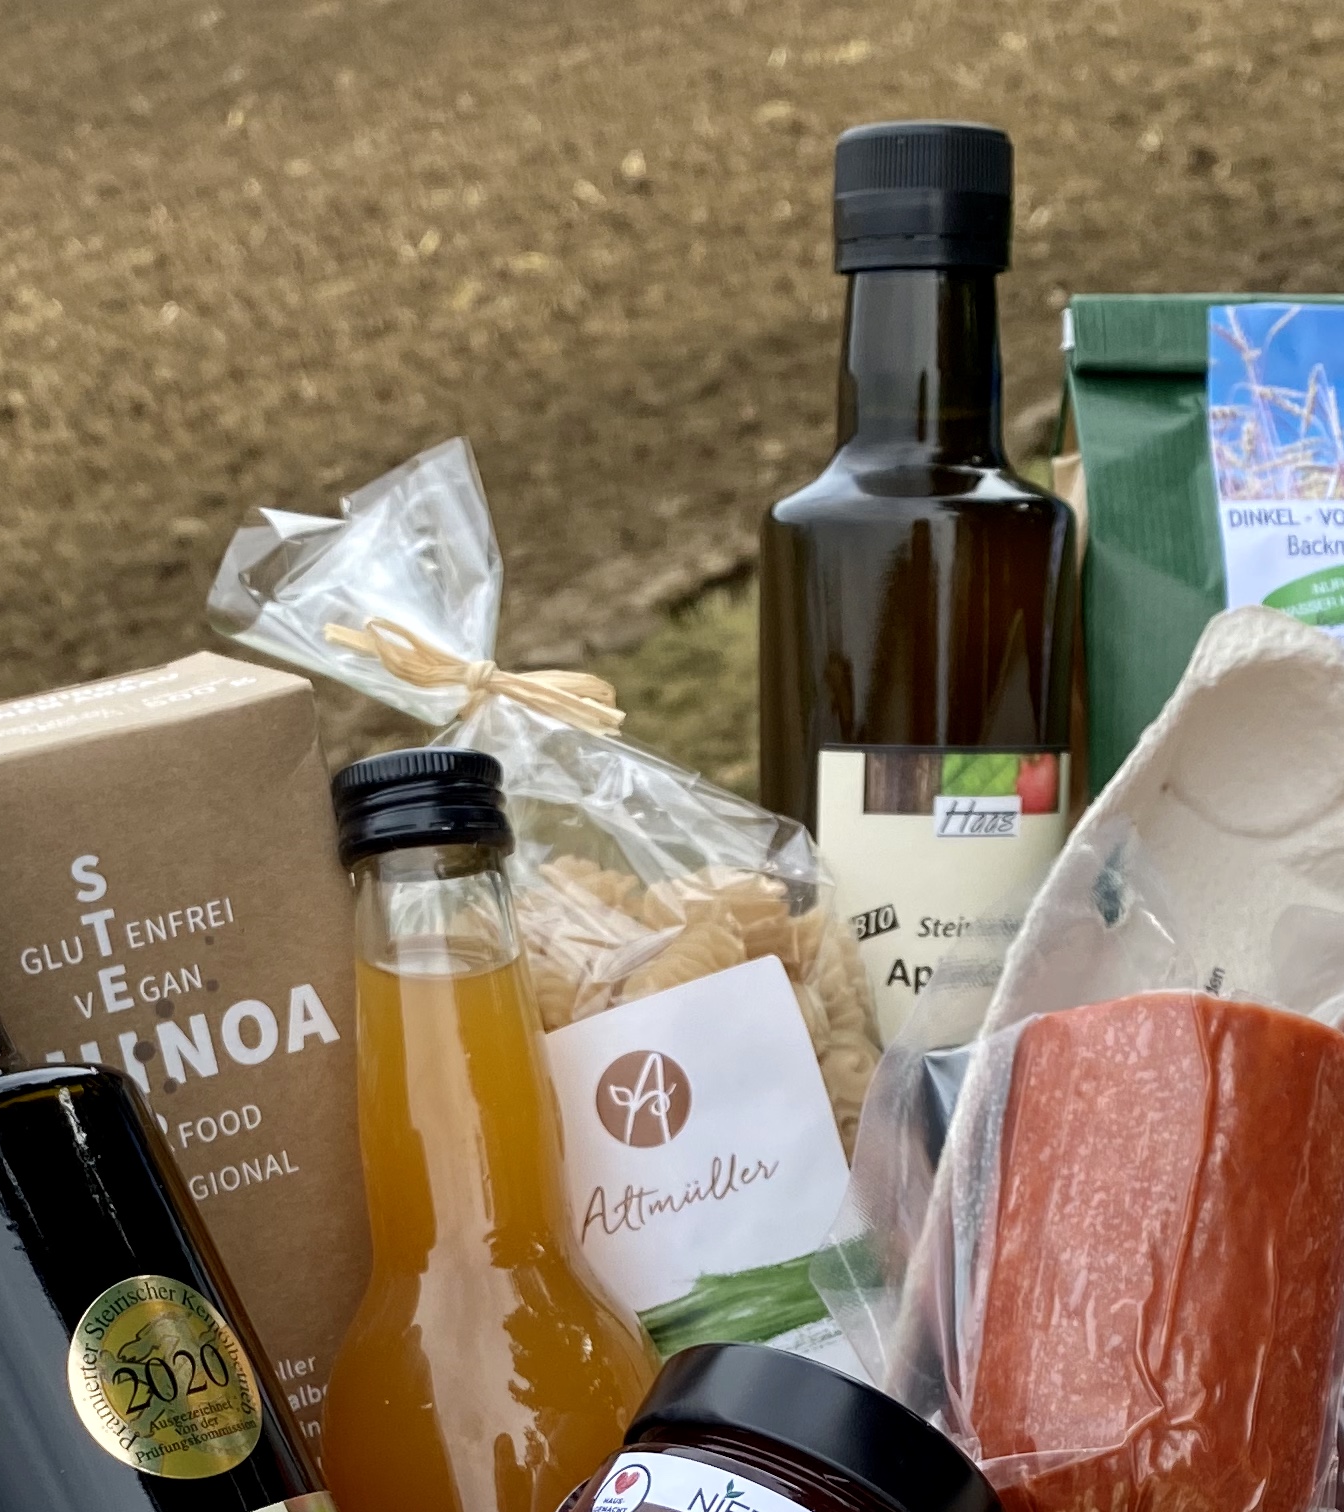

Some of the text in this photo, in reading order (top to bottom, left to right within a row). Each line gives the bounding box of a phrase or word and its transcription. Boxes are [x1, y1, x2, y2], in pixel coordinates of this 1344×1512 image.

[1229, 507, 1300, 528] DINKEL
[178, 1103, 263, 1149] FOOD
[188, 1149, 301, 1202] GIONAL
[84, 1281, 177, 1341] Steirischer
[111, 1343, 230, 1416] 2020
[149, 1398, 234, 1434] Ausgezeichnet
[174, 1415, 220, 1437] von der
[134, 1419, 257, 1464] Prüfungskommission
